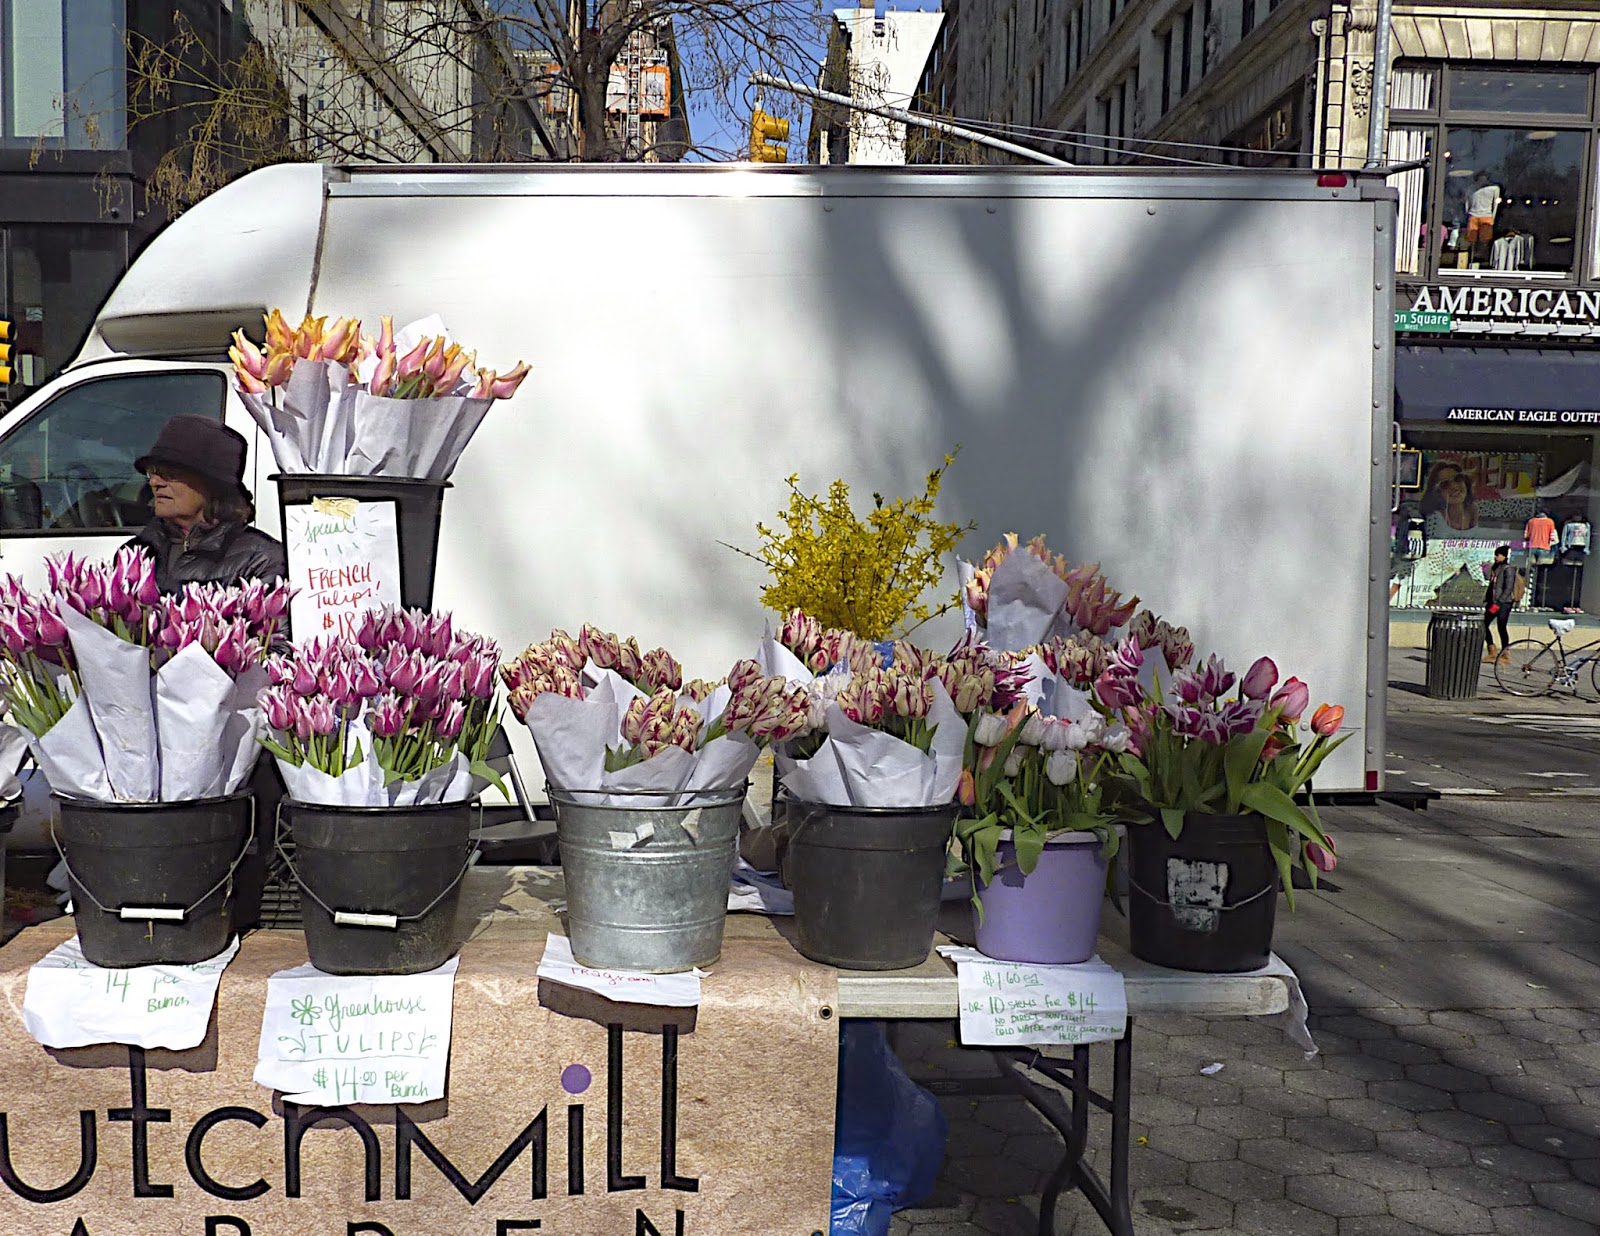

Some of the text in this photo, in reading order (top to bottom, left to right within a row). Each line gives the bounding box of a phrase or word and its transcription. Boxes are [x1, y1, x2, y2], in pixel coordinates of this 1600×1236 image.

[1410, 286, 1600, 320] AMERICAN
[1410, 313, 1448, 326] Square
[1447, 408, 1515, 421] AMERICAN
[1519, 410, 1557, 422] EAGLE
[308, 562, 372, 590] FRENCH
[322, 611, 359, 645] $18
[324, 993, 426, 1033] Greenhouse
[988, 996, 1006, 1015] 10
[1067, 991, 1098, 1015] $14
[995, 1017, 1006, 1025] NO
[1010, 1013, 1039, 1023] DIRECT
[309, 1032, 416, 1054] TULIPS
[390, 1080, 429, 1098] Bunch
